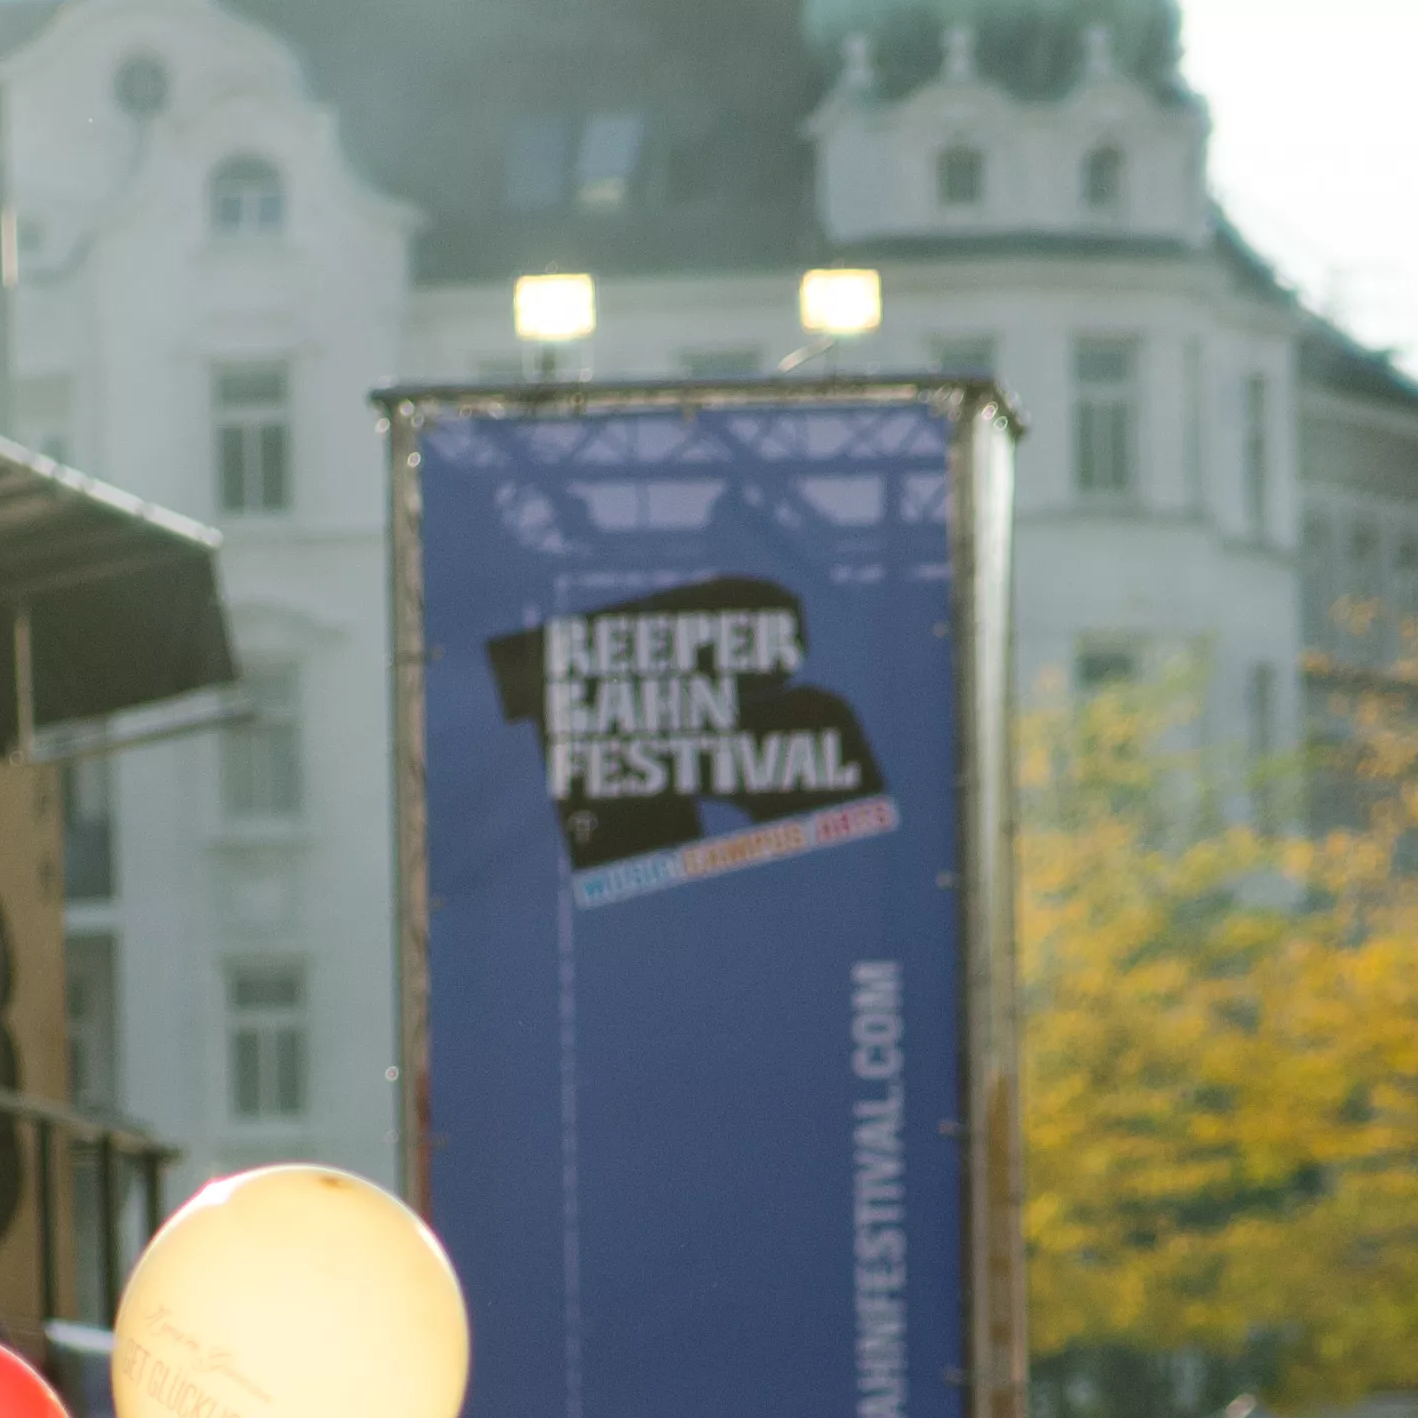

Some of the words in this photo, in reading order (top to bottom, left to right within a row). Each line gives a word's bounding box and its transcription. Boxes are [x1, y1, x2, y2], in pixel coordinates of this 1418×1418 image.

[545, 608, 804, 674] REEPER
[545, 675, 739, 734] BAHN
[546, 727, 862, 800] FESTIVAL
